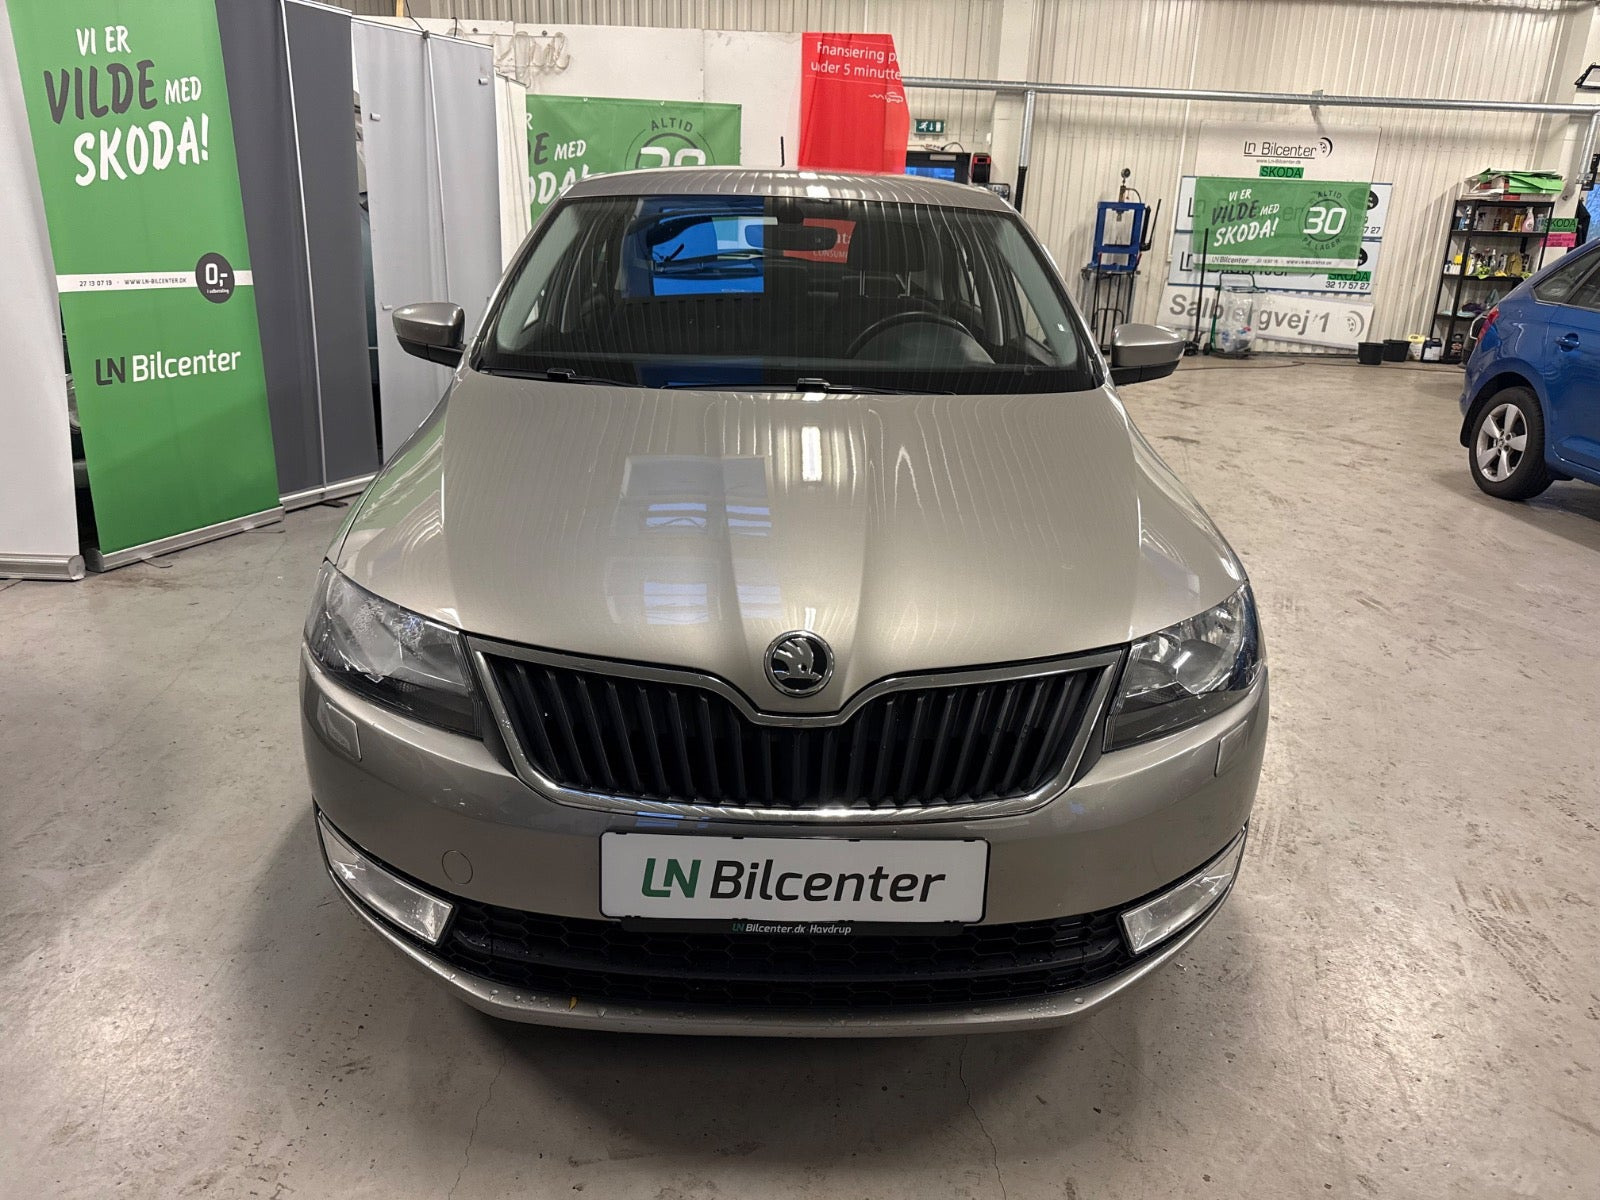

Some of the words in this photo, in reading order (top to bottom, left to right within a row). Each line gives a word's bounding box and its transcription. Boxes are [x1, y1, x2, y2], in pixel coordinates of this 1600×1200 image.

[76, 28, 97, 56] VI
[105, 25, 131, 54] ER
[816, 42, 884, 64] Fnansiering
[888, 52, 898, 64] p
[843, 63, 851, 75] 5
[44, 59, 157, 125] VILDE
[165, 76, 202, 105] MED
[650, 117, 693, 132] ALTID
[73, 113, 209, 187] SKODA!
[554, 139, 587, 161] MED
[1243, 141, 1257, 155] Ln
[1261, 141, 1317, 157] Bilcenter
[1260, 166, 1303, 178] SKODA
[1228, 190, 1238, 202] VI
[1240, 188, 1252, 200] ER
[1317, 190, 1342, 199] ALTID
[1211, 200, 1259, 226] VILDE
[1260, 203, 1280, 216] MED
[1302, 206, 1347, 234] 30
[1213, 217, 1279, 247] SKODA!
[1370, 226, 1381, 234] 27
[1314, 237, 1341, 251] LAGER
[1220, 256, 1249, 264] Bilcenter
[1338, 281, 1347, 289] 17
[1360, 282, 1370, 290] 27
[1318, 312, 1331, 333] 1
[95, 356, 126, 386] LN
[132, 349, 241, 382] Bilcenter
[641, 857, 702, 898] LN
[709, 859, 946, 902] Bilcenter
[745, 923, 805, 934] Bilcenter.dk
[809, 924, 852, 936] Havdrup
